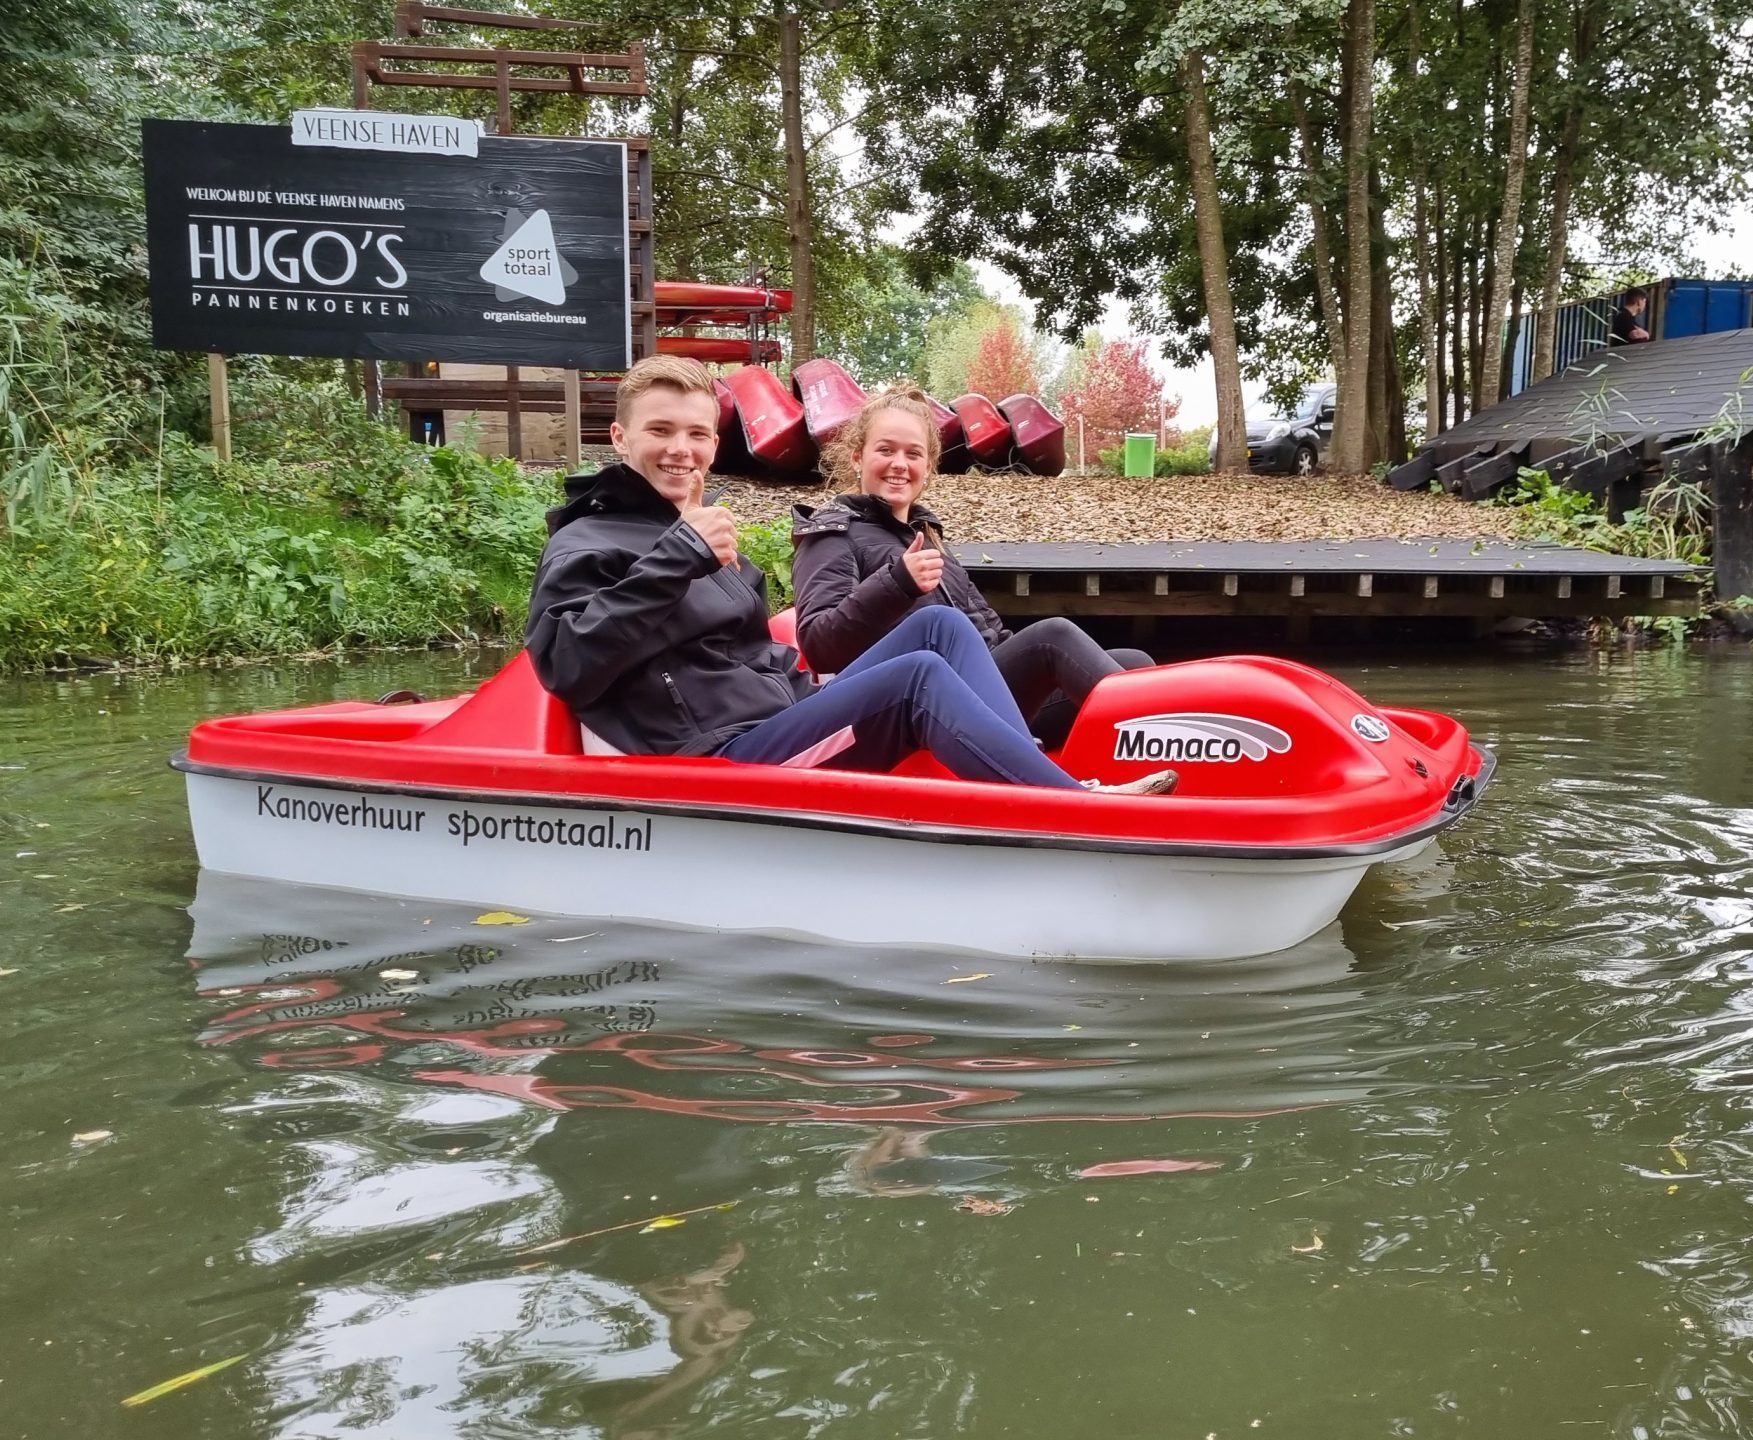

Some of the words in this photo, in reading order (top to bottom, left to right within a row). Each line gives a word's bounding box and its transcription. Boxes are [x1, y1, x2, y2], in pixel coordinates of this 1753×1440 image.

[303, 117, 385, 144] VEENSE
[392, 123, 459, 148] HAVEN
[186, 187, 236, 202] WELKOM
[238, 190, 255, 203] BIJ
[257, 191, 272, 204] DE
[275, 192, 318, 206] VEENSE
[320, 195, 357, 208] HAVEN
[358, 197, 405, 211] NAMENS
[188, 224, 408, 289] HUGO'S
[508, 248, 551, 262] sport
[504, 262, 551, 276] totaal
[192, 293, 409, 316] PANNENKOEKEN
[483, 311, 586, 324] organisatiebureau
[1116, 730, 1241, 760] Monaco
[257, 785, 426, 832] Kanoverhuur
[447, 810, 652, 851] sporttotaal.nl
